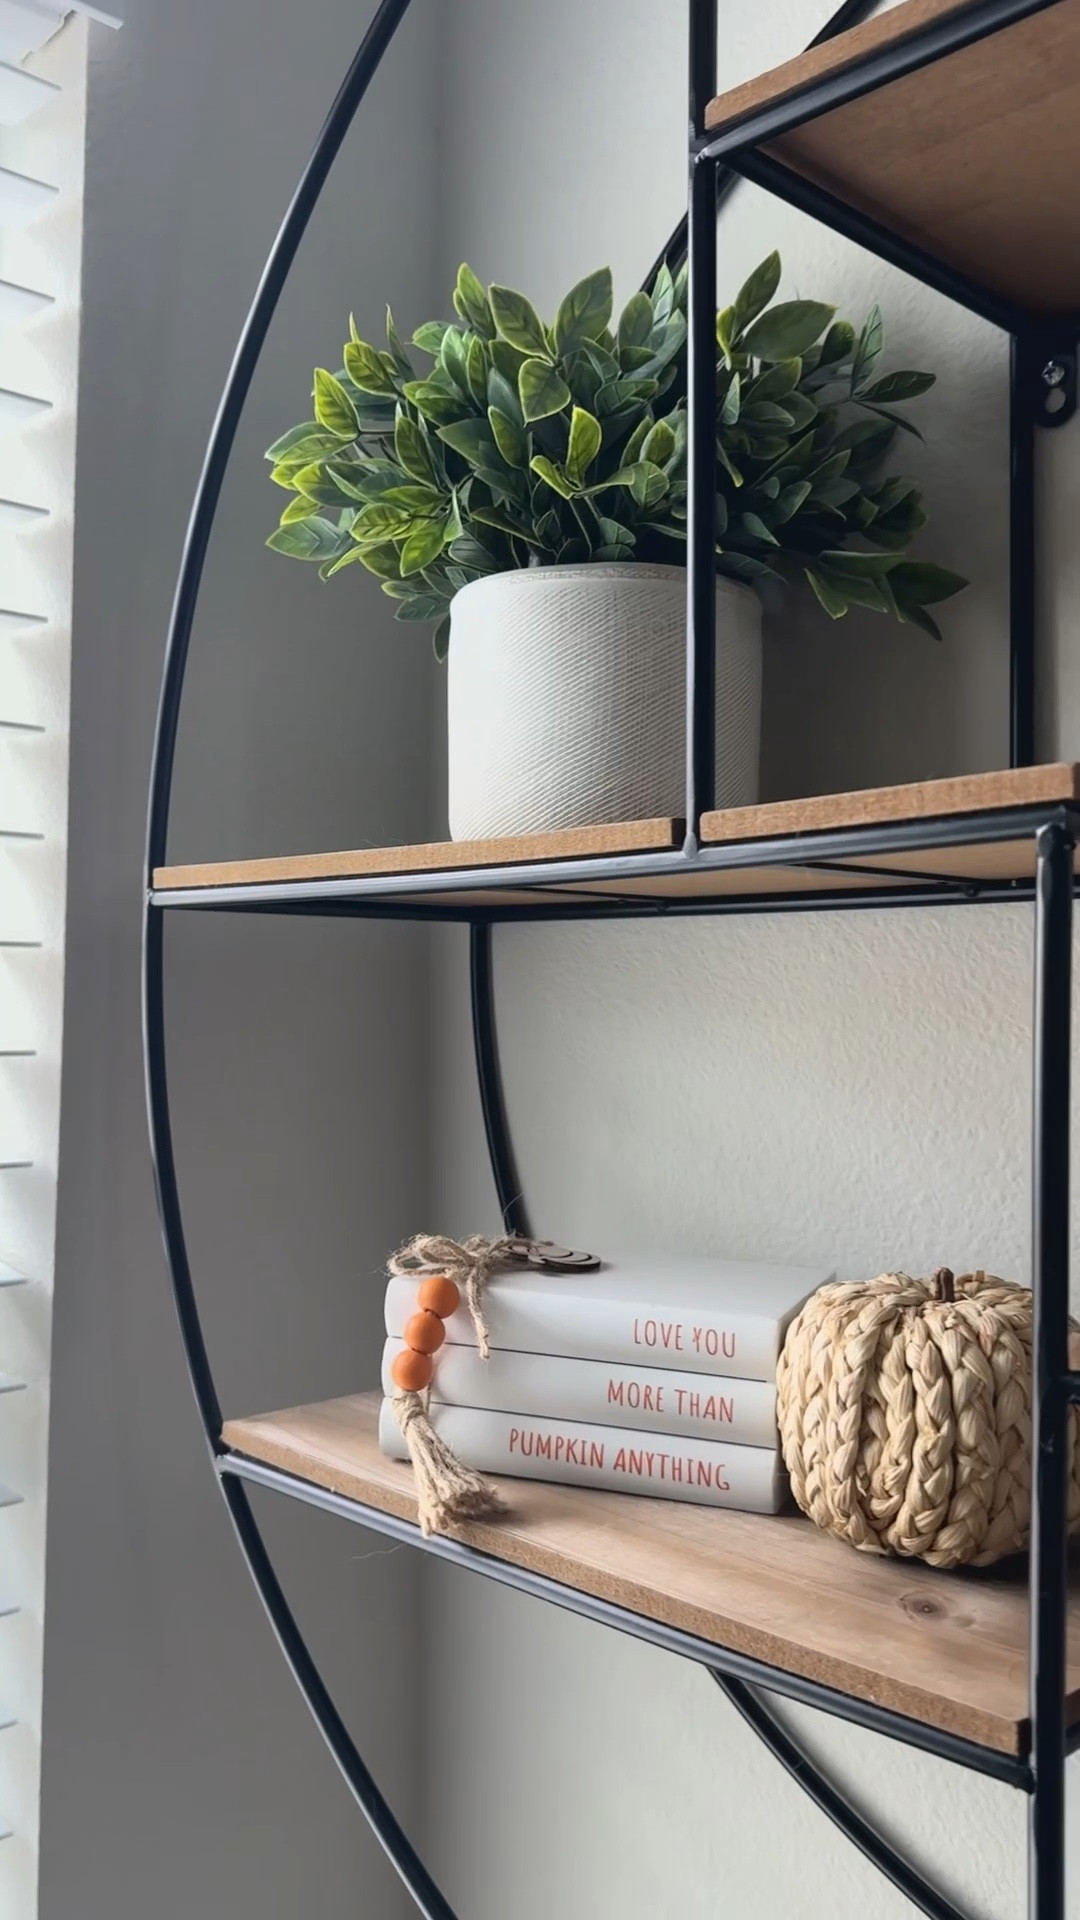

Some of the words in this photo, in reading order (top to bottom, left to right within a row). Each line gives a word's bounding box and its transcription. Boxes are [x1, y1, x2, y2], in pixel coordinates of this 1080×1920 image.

[633, 1318, 684, 1351] LOVE
[692, 1326, 737, 1358] YOU
[608, 1379, 664, 1413] MORE
[675, 1388, 735, 1424] THAN
[509, 1428, 605, 1469] PUMPKIN
[613, 1447, 730, 1491] ANYTHING
